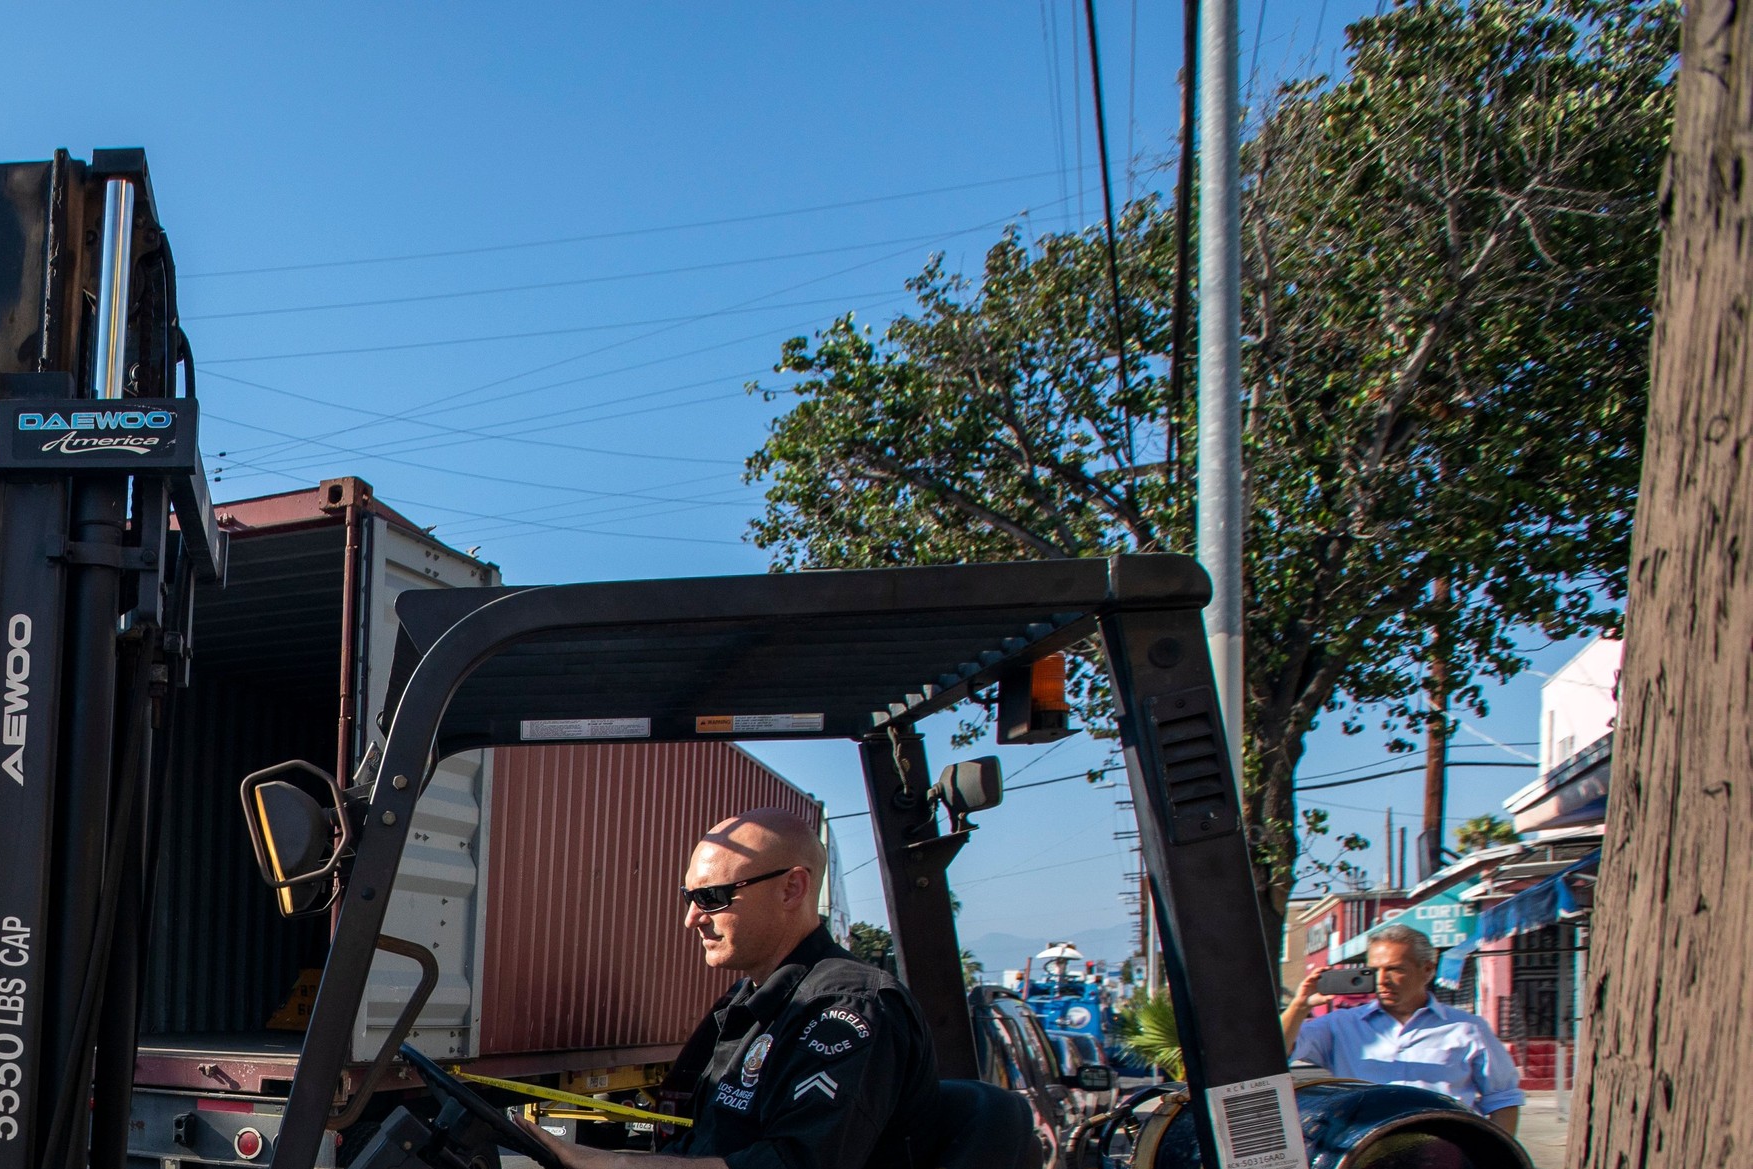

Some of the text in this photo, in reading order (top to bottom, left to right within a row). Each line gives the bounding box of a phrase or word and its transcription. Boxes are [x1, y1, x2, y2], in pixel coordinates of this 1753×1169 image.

[18, 411, 172, 430] DAEWOO
[41, 430, 160, 454] America
[1, 613, 33, 786] AEWOO
[1416, 903, 1475, 919] CORTE
[1432, 919, 1457, 933] DE
[0, 915, 31, 968] CAP
[799, 1010, 870, 1041] LOS ANGELES
[808, 1039, 852, 1055] POLICE
[718, 1082, 733, 1094] LOS
